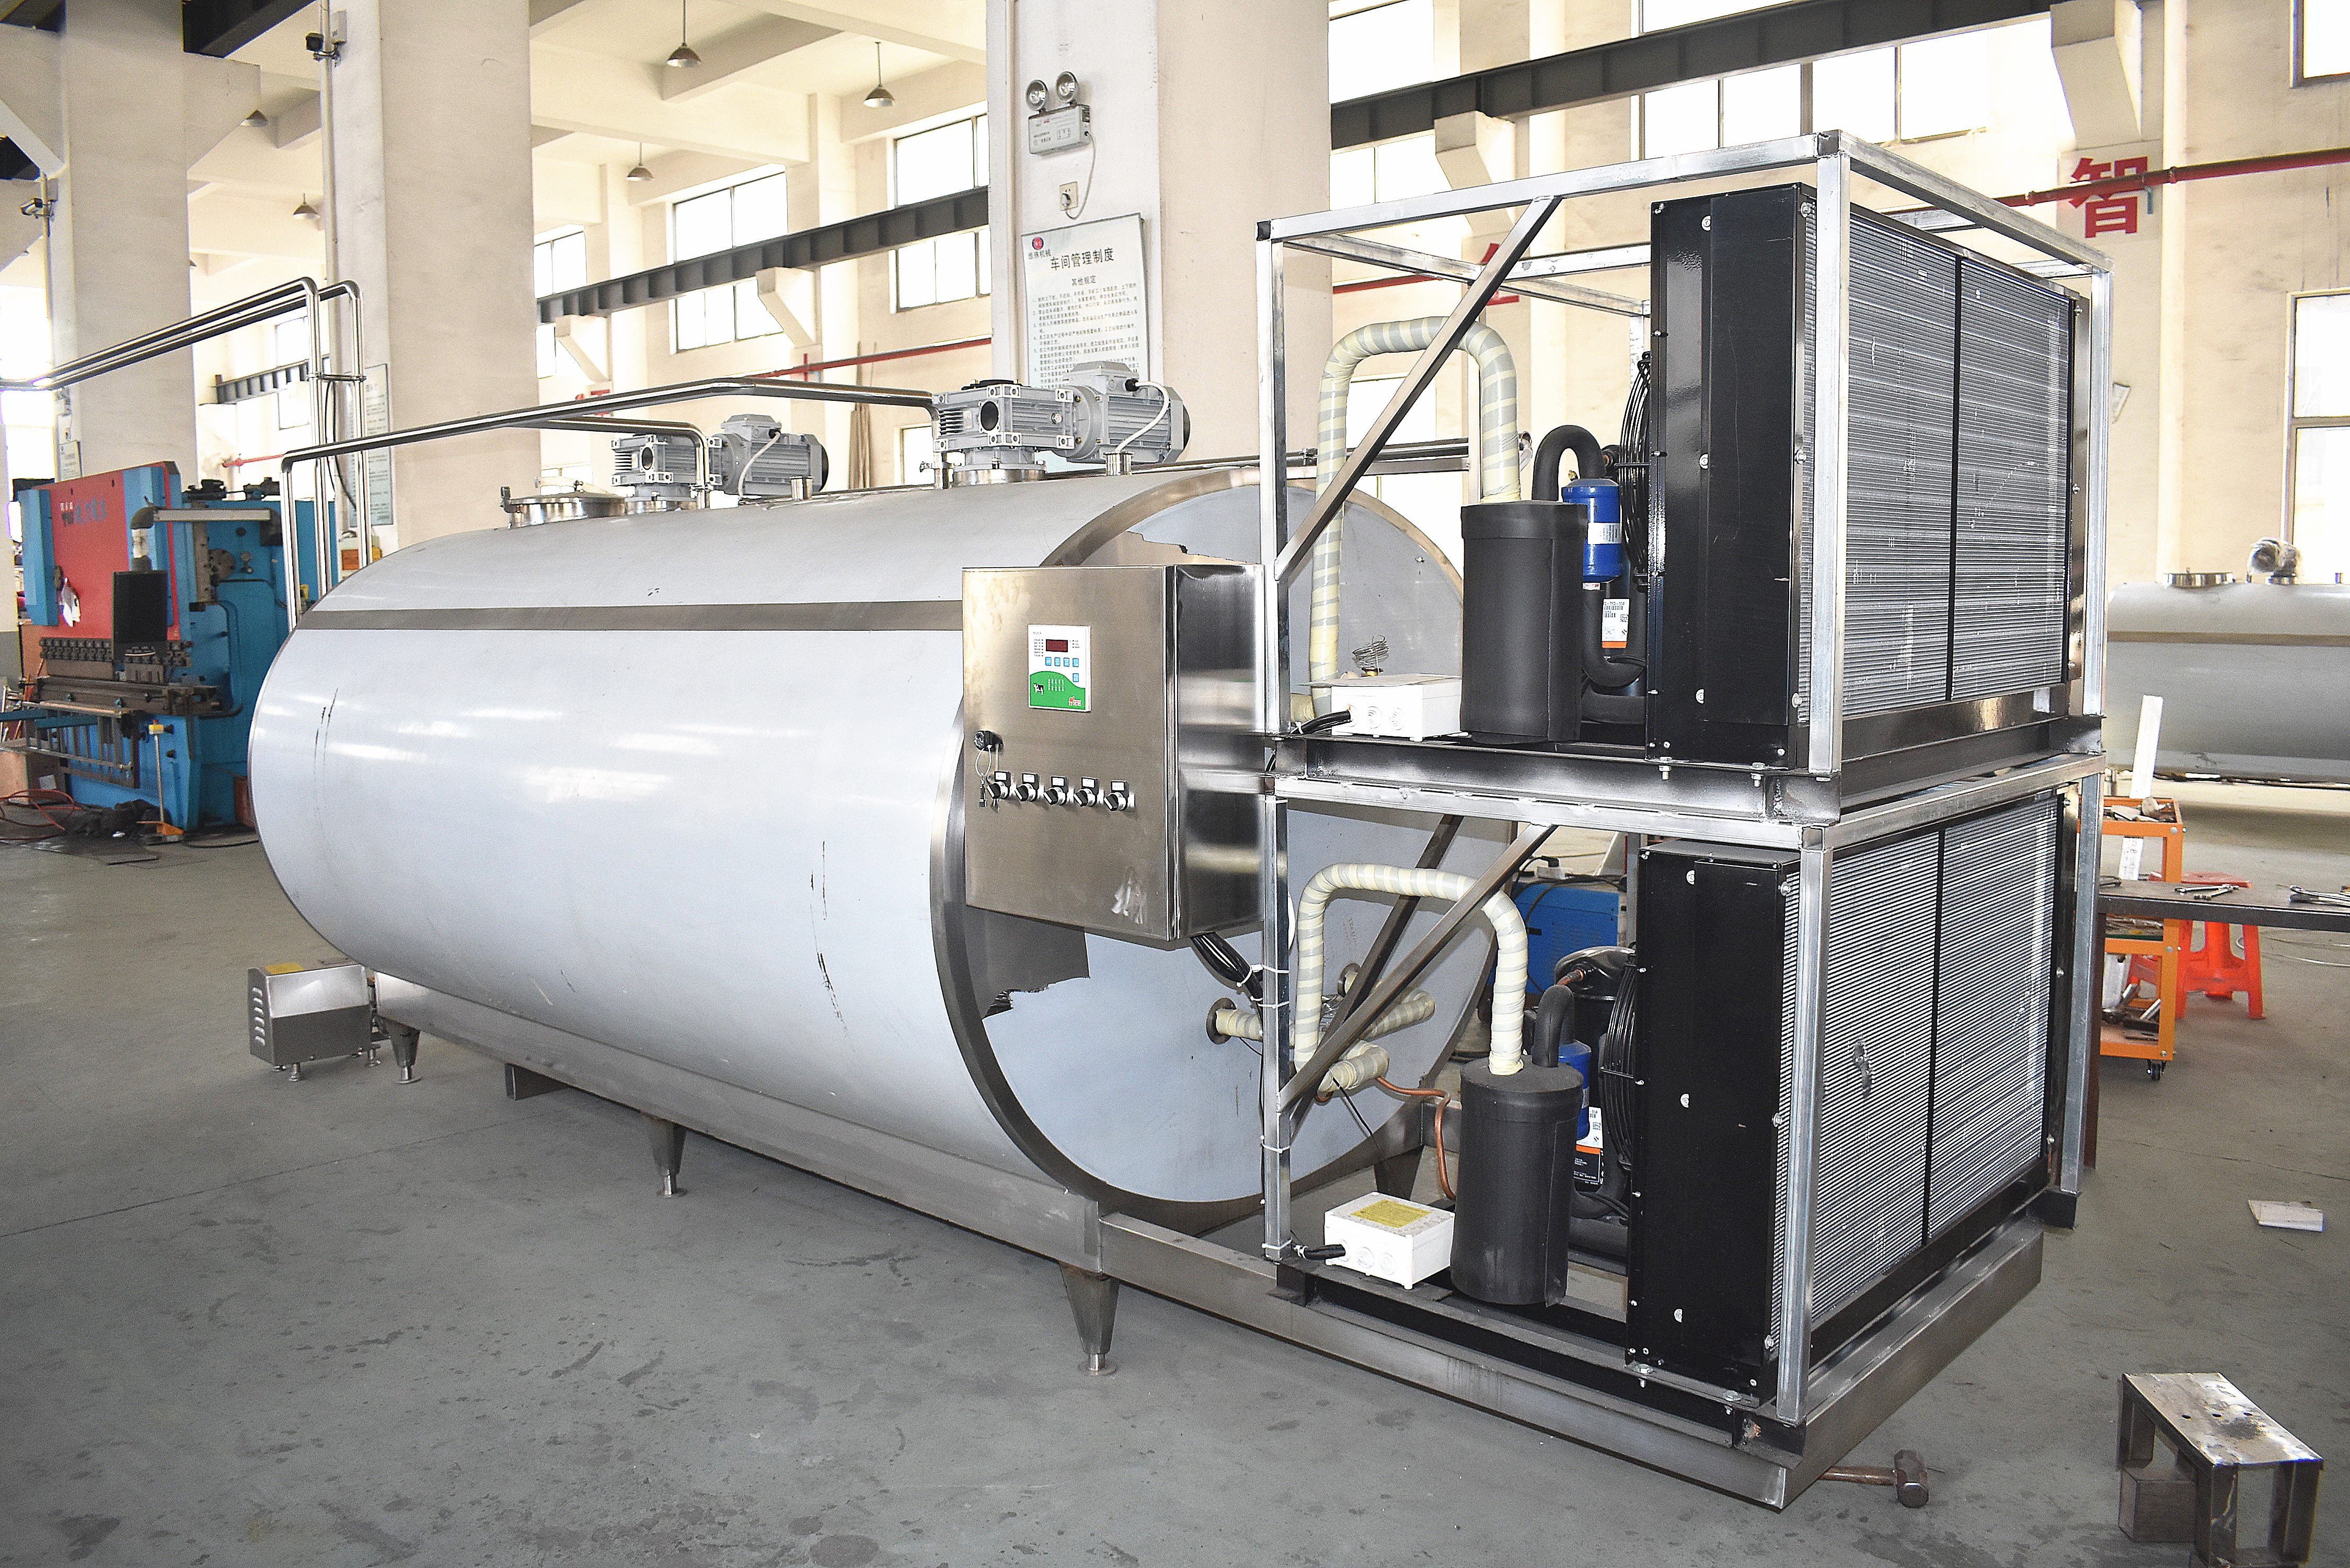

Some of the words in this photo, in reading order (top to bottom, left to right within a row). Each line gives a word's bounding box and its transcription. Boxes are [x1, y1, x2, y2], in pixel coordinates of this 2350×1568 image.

[2068, 156, 2148, 238] 智
[1050, 247, 1114, 270] 车间管理制度
[1072, 275, 1096, 286] 其他规定
